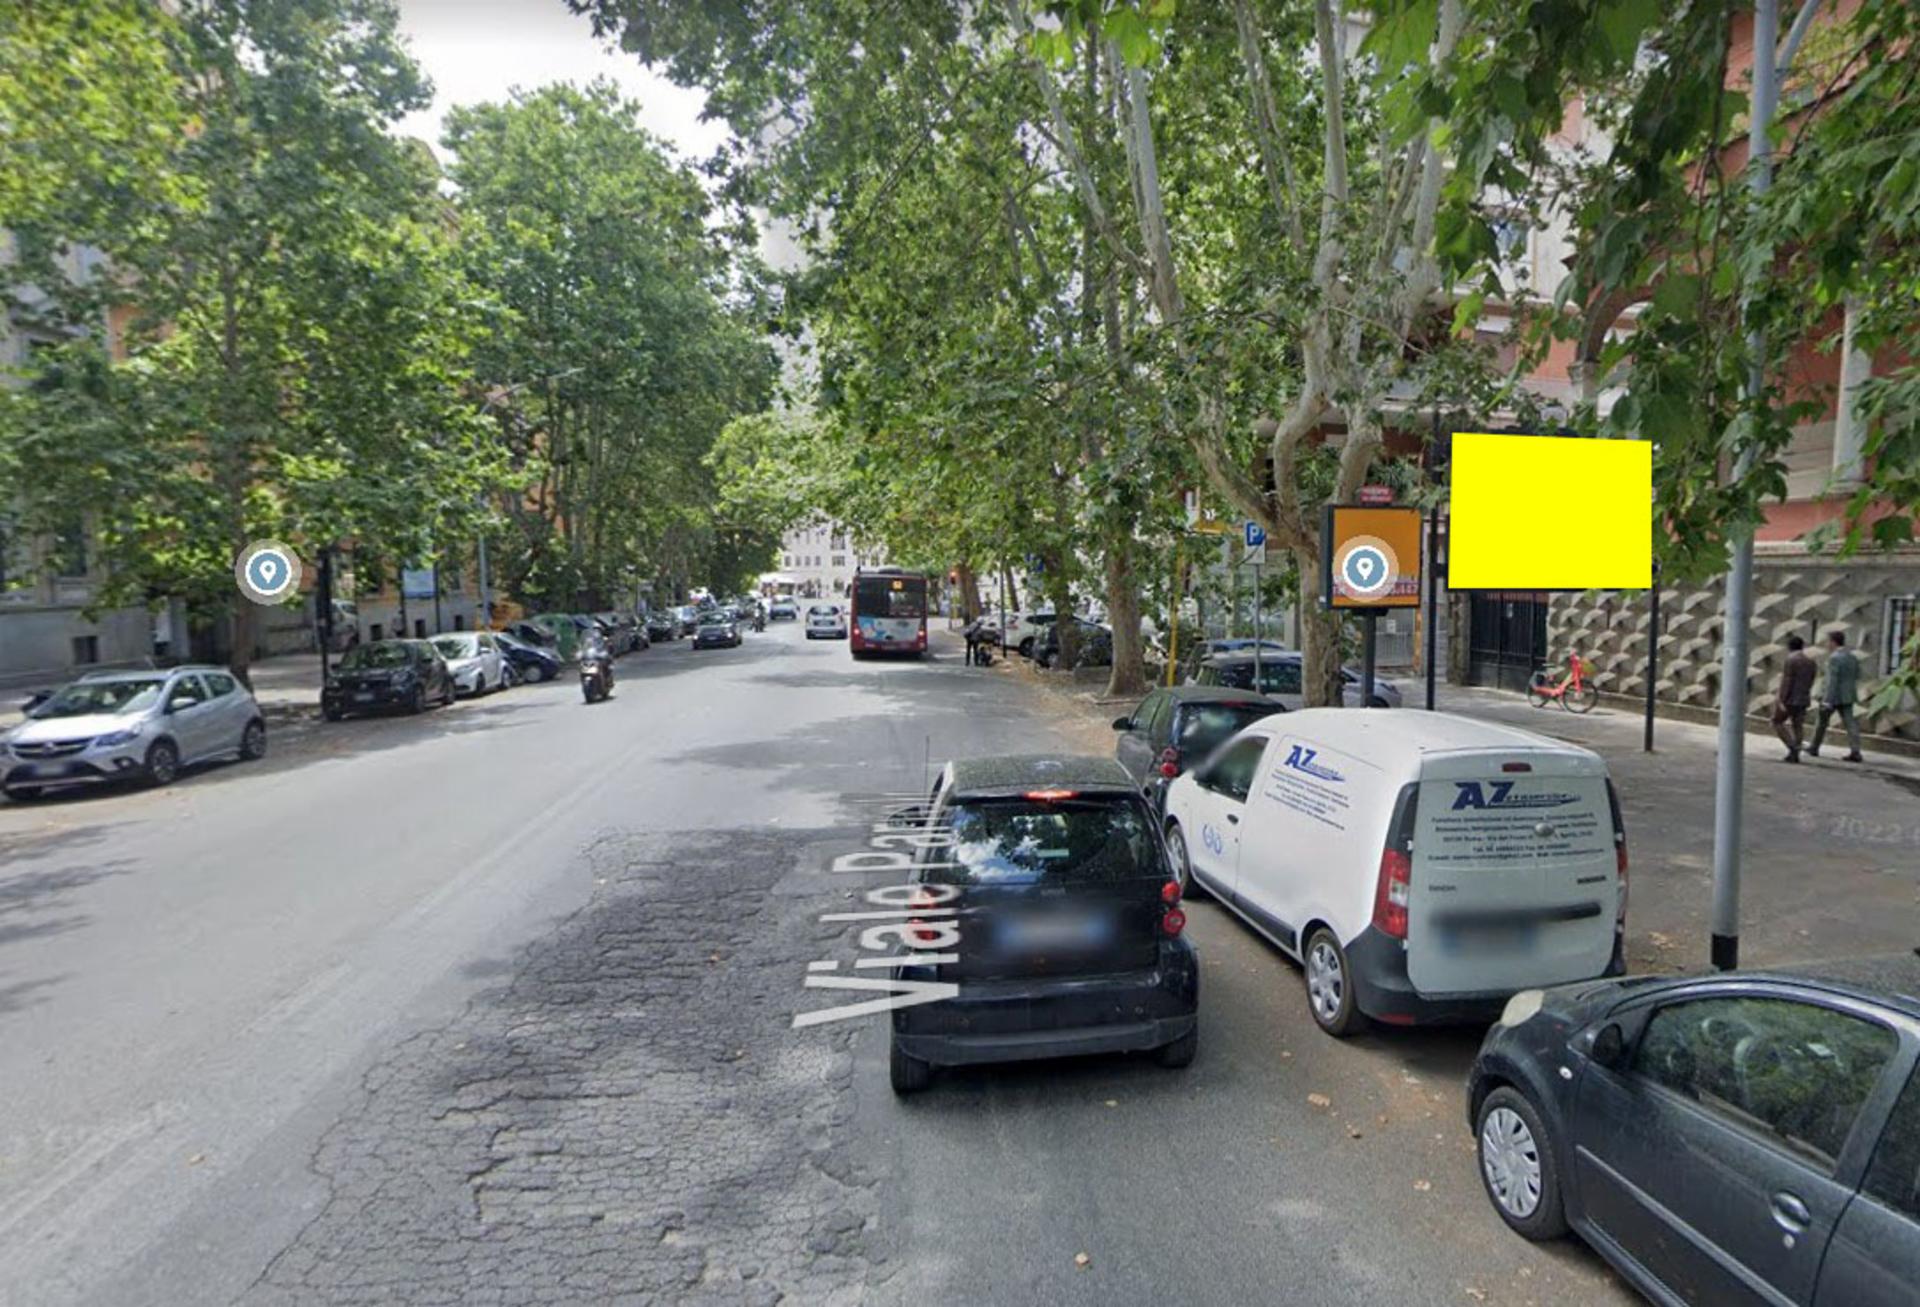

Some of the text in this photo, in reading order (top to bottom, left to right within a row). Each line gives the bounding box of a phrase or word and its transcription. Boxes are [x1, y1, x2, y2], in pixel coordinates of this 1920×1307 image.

[1249, 524, 1260, 543] P
[1283, 745, 1317, 769] AZ
[1452, 781, 1515, 810] AZ
